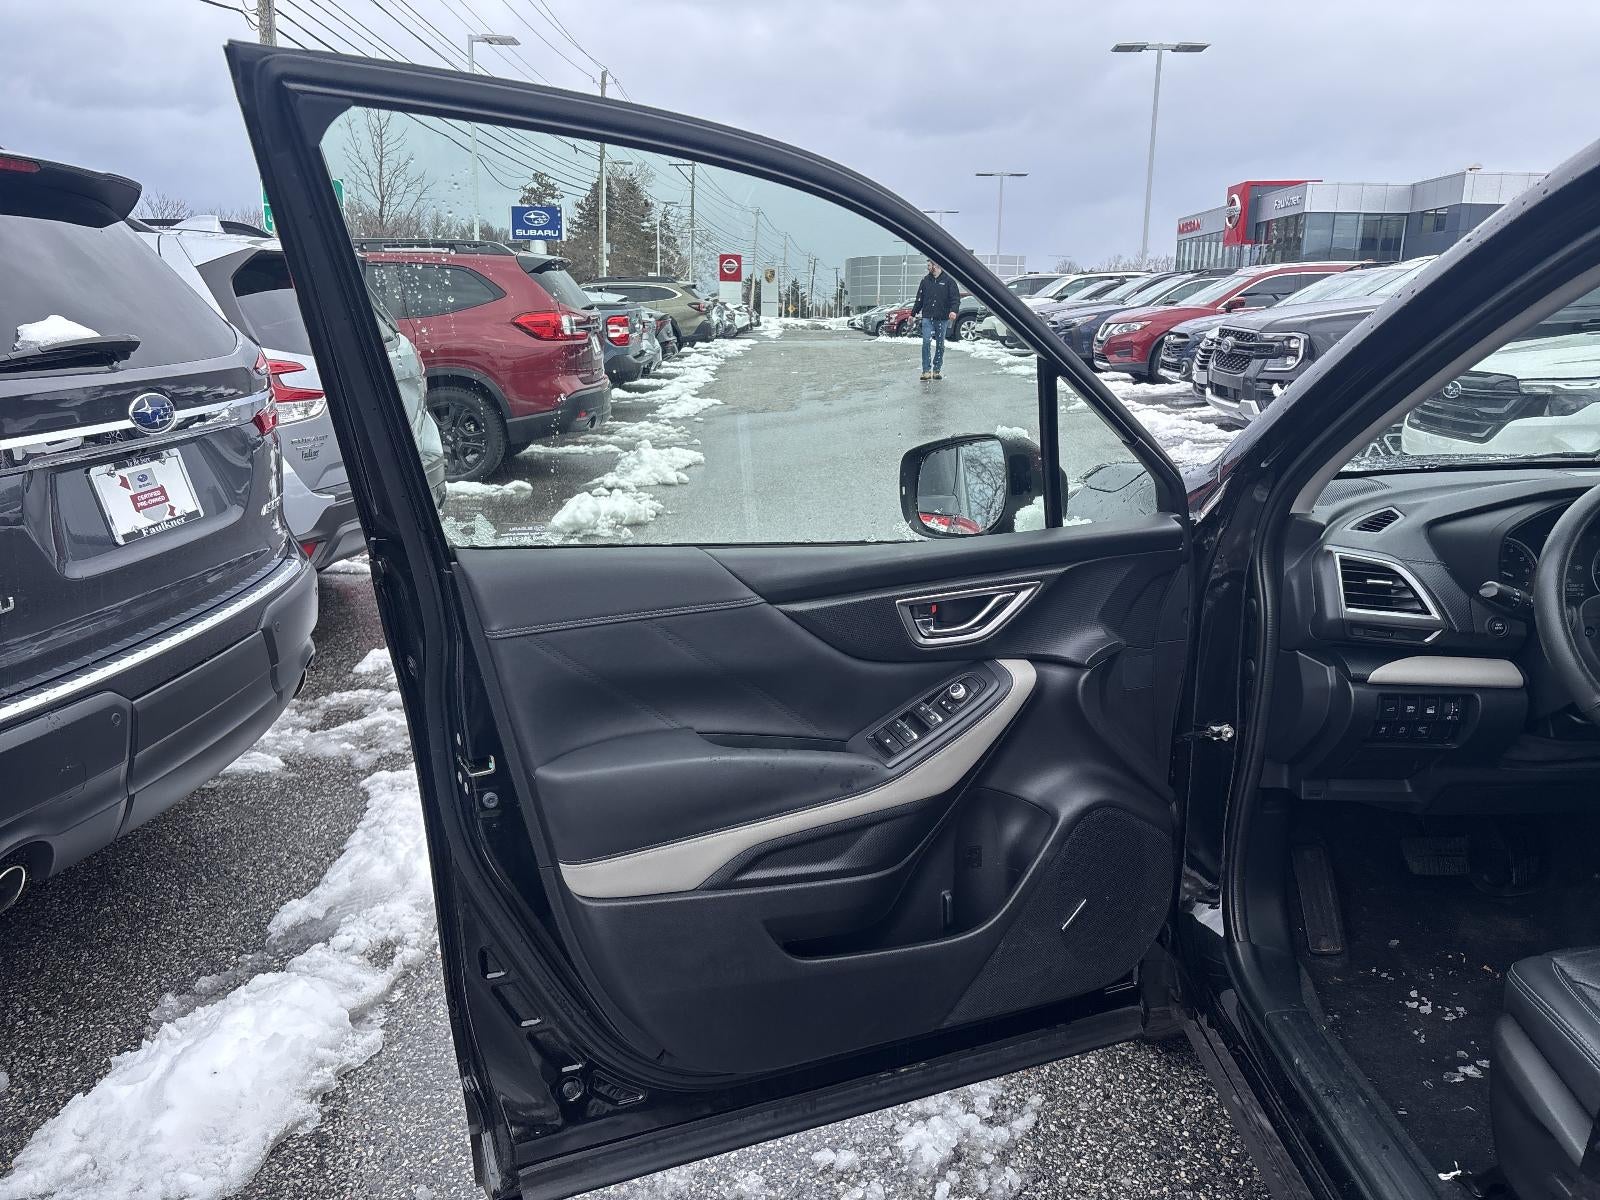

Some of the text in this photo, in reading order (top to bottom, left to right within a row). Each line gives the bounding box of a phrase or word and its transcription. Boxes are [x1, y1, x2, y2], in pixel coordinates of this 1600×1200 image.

[515, 229, 559, 237] SUBARU
[137, 490, 162, 501] CERTIFIED
[137, 496, 166, 507] PRE-OWNED
[141, 516, 187, 537] Faulkner
